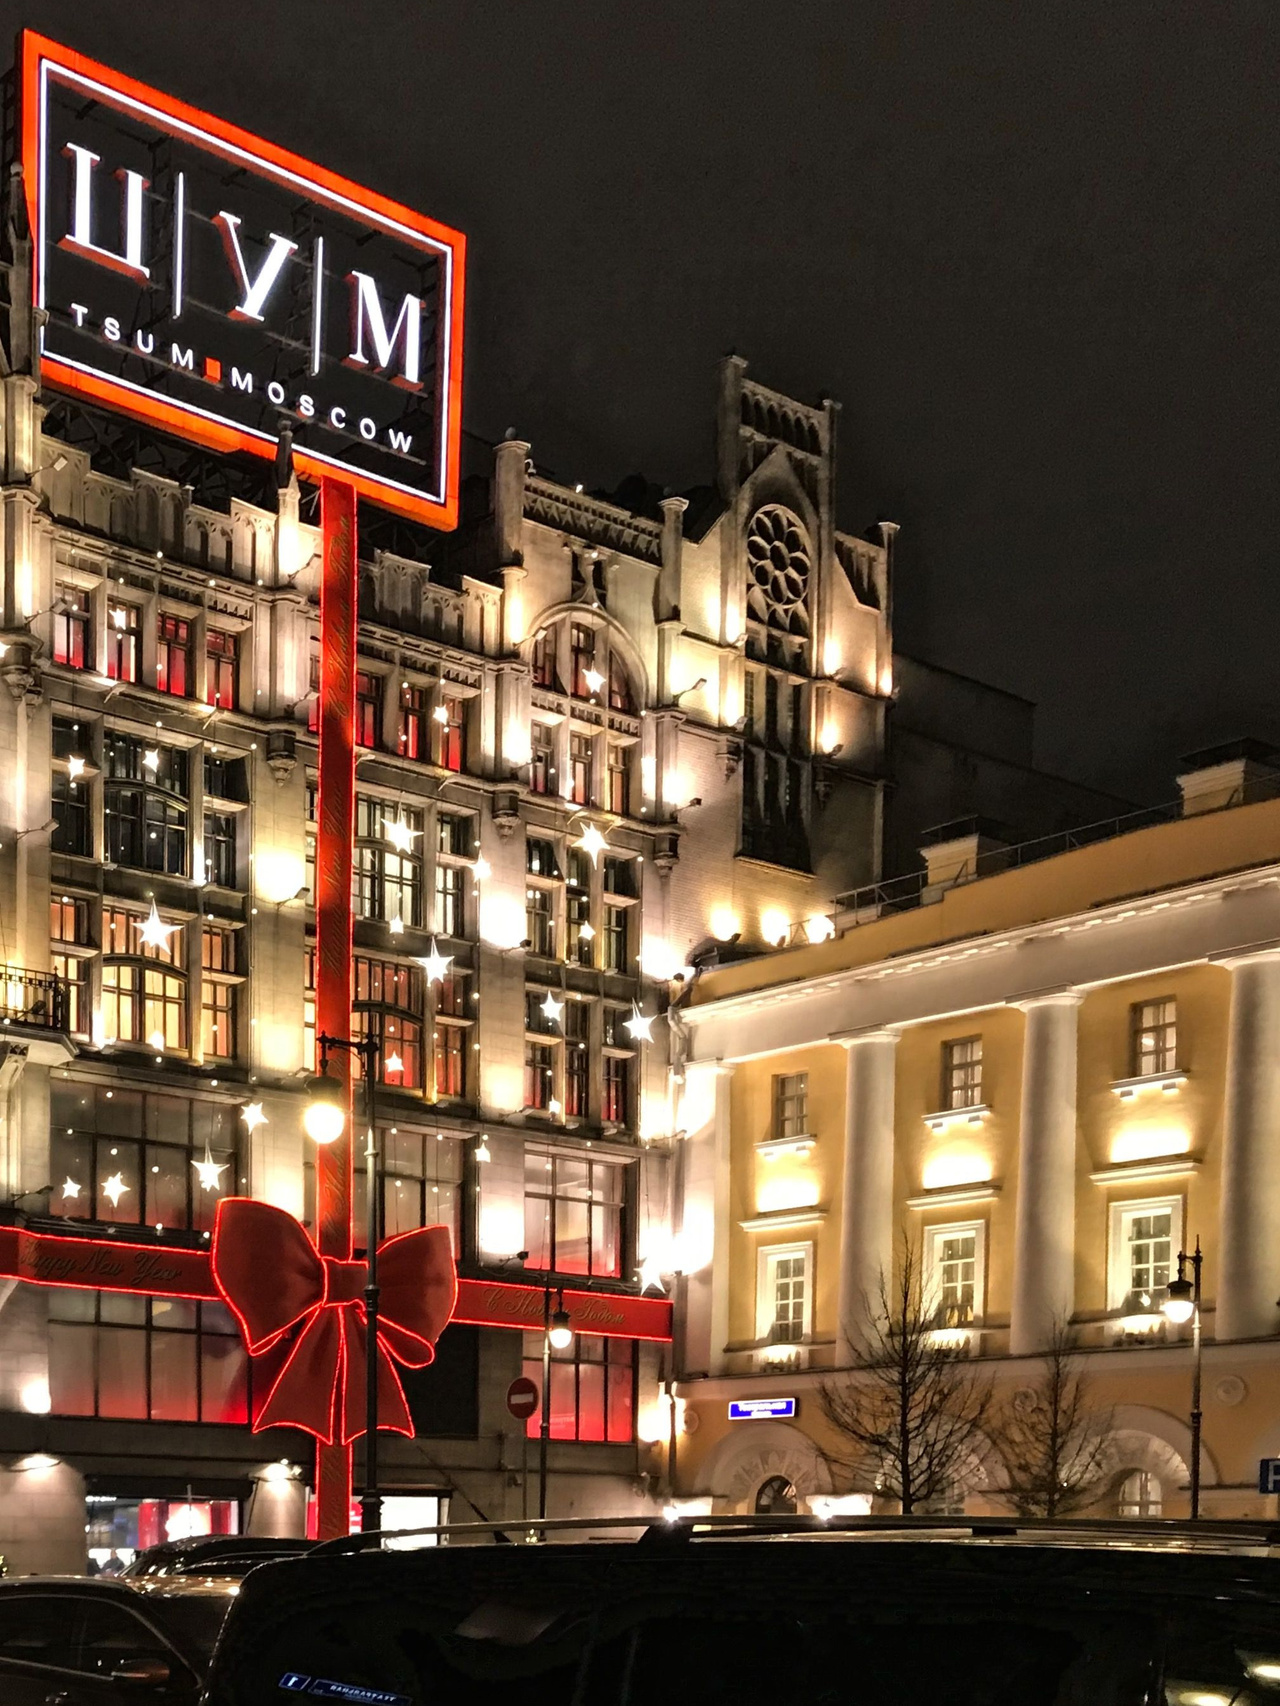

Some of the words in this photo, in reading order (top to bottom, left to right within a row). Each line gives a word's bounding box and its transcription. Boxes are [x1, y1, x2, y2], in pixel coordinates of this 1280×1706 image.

[70, 302, 195, 370] TSUM
[231, 366, 413, 454] MOSCOW
[76, 1246, 125, 1277] New
[130, 1252, 183, 1286] Year
